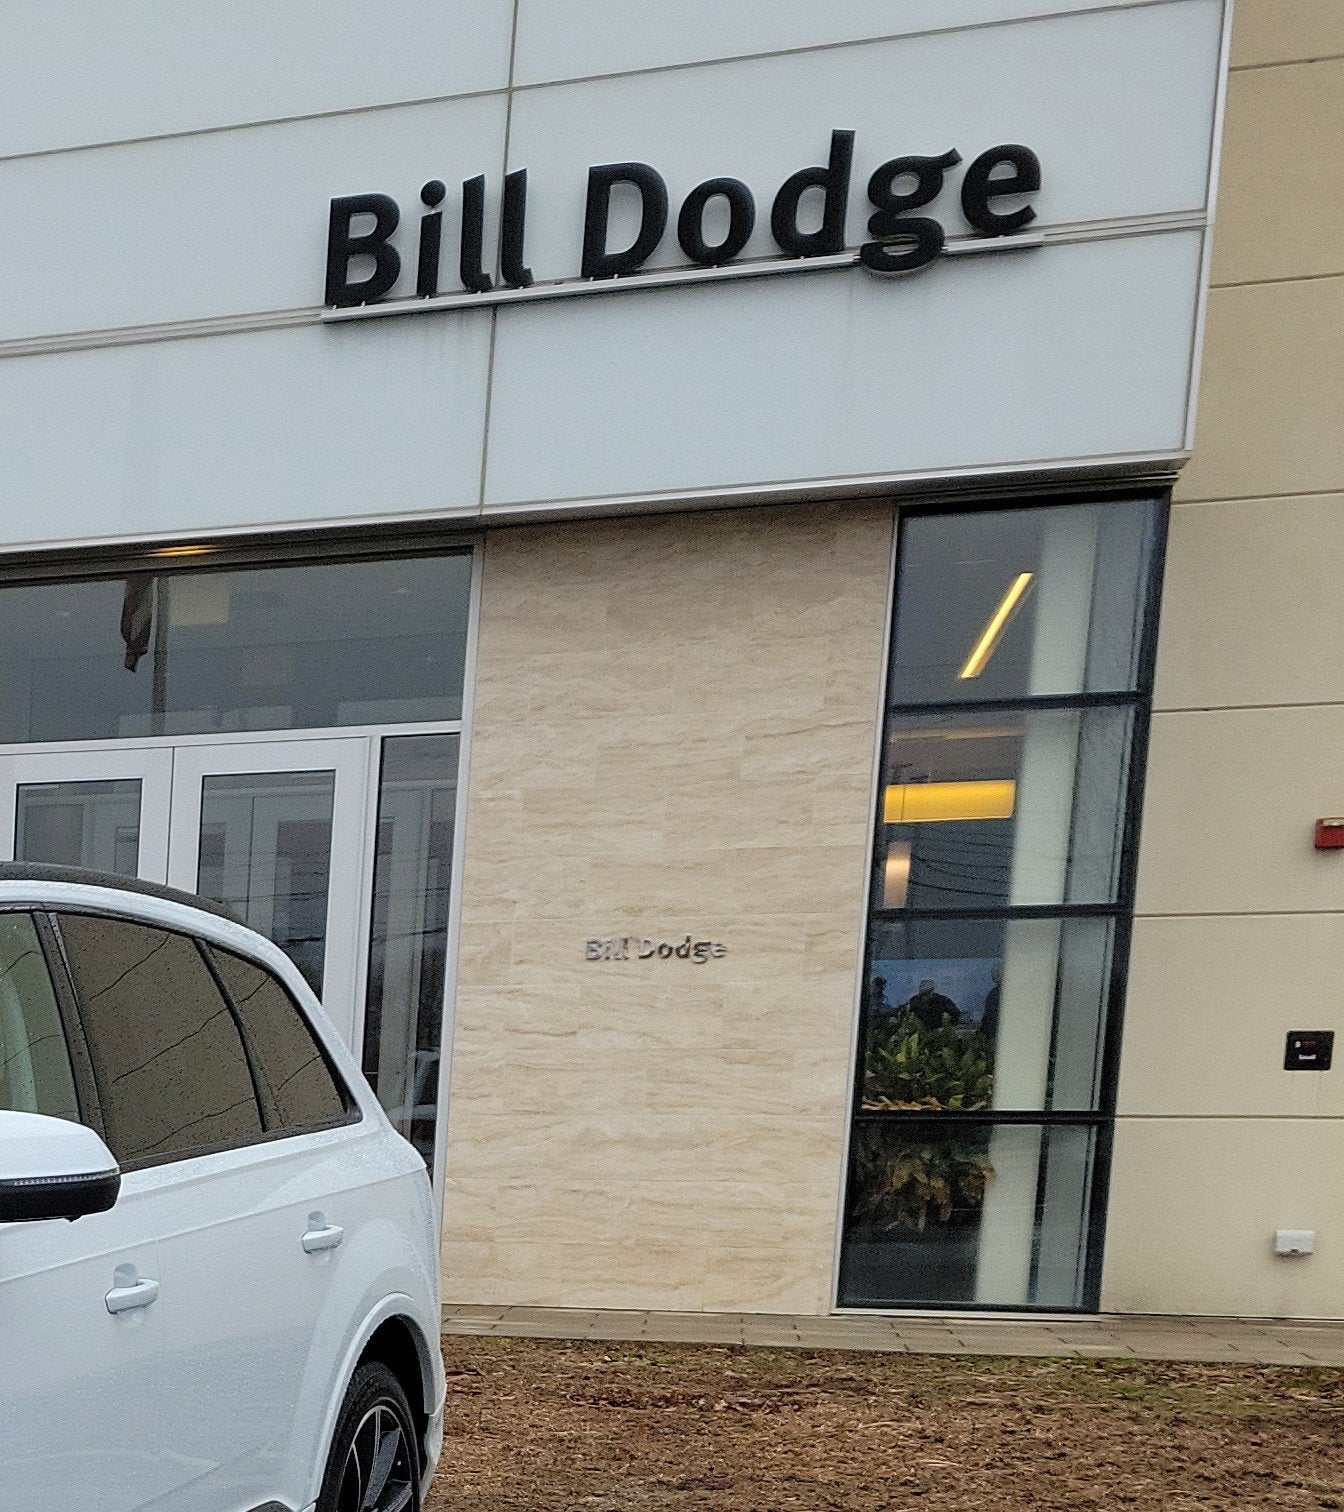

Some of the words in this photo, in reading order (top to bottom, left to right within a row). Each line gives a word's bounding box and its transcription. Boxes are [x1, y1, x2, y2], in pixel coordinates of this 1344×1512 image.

[324, 168, 533, 307] Bill
[581, 129, 1043, 276] Dodge
[635, 935, 727, 964] Dodge
